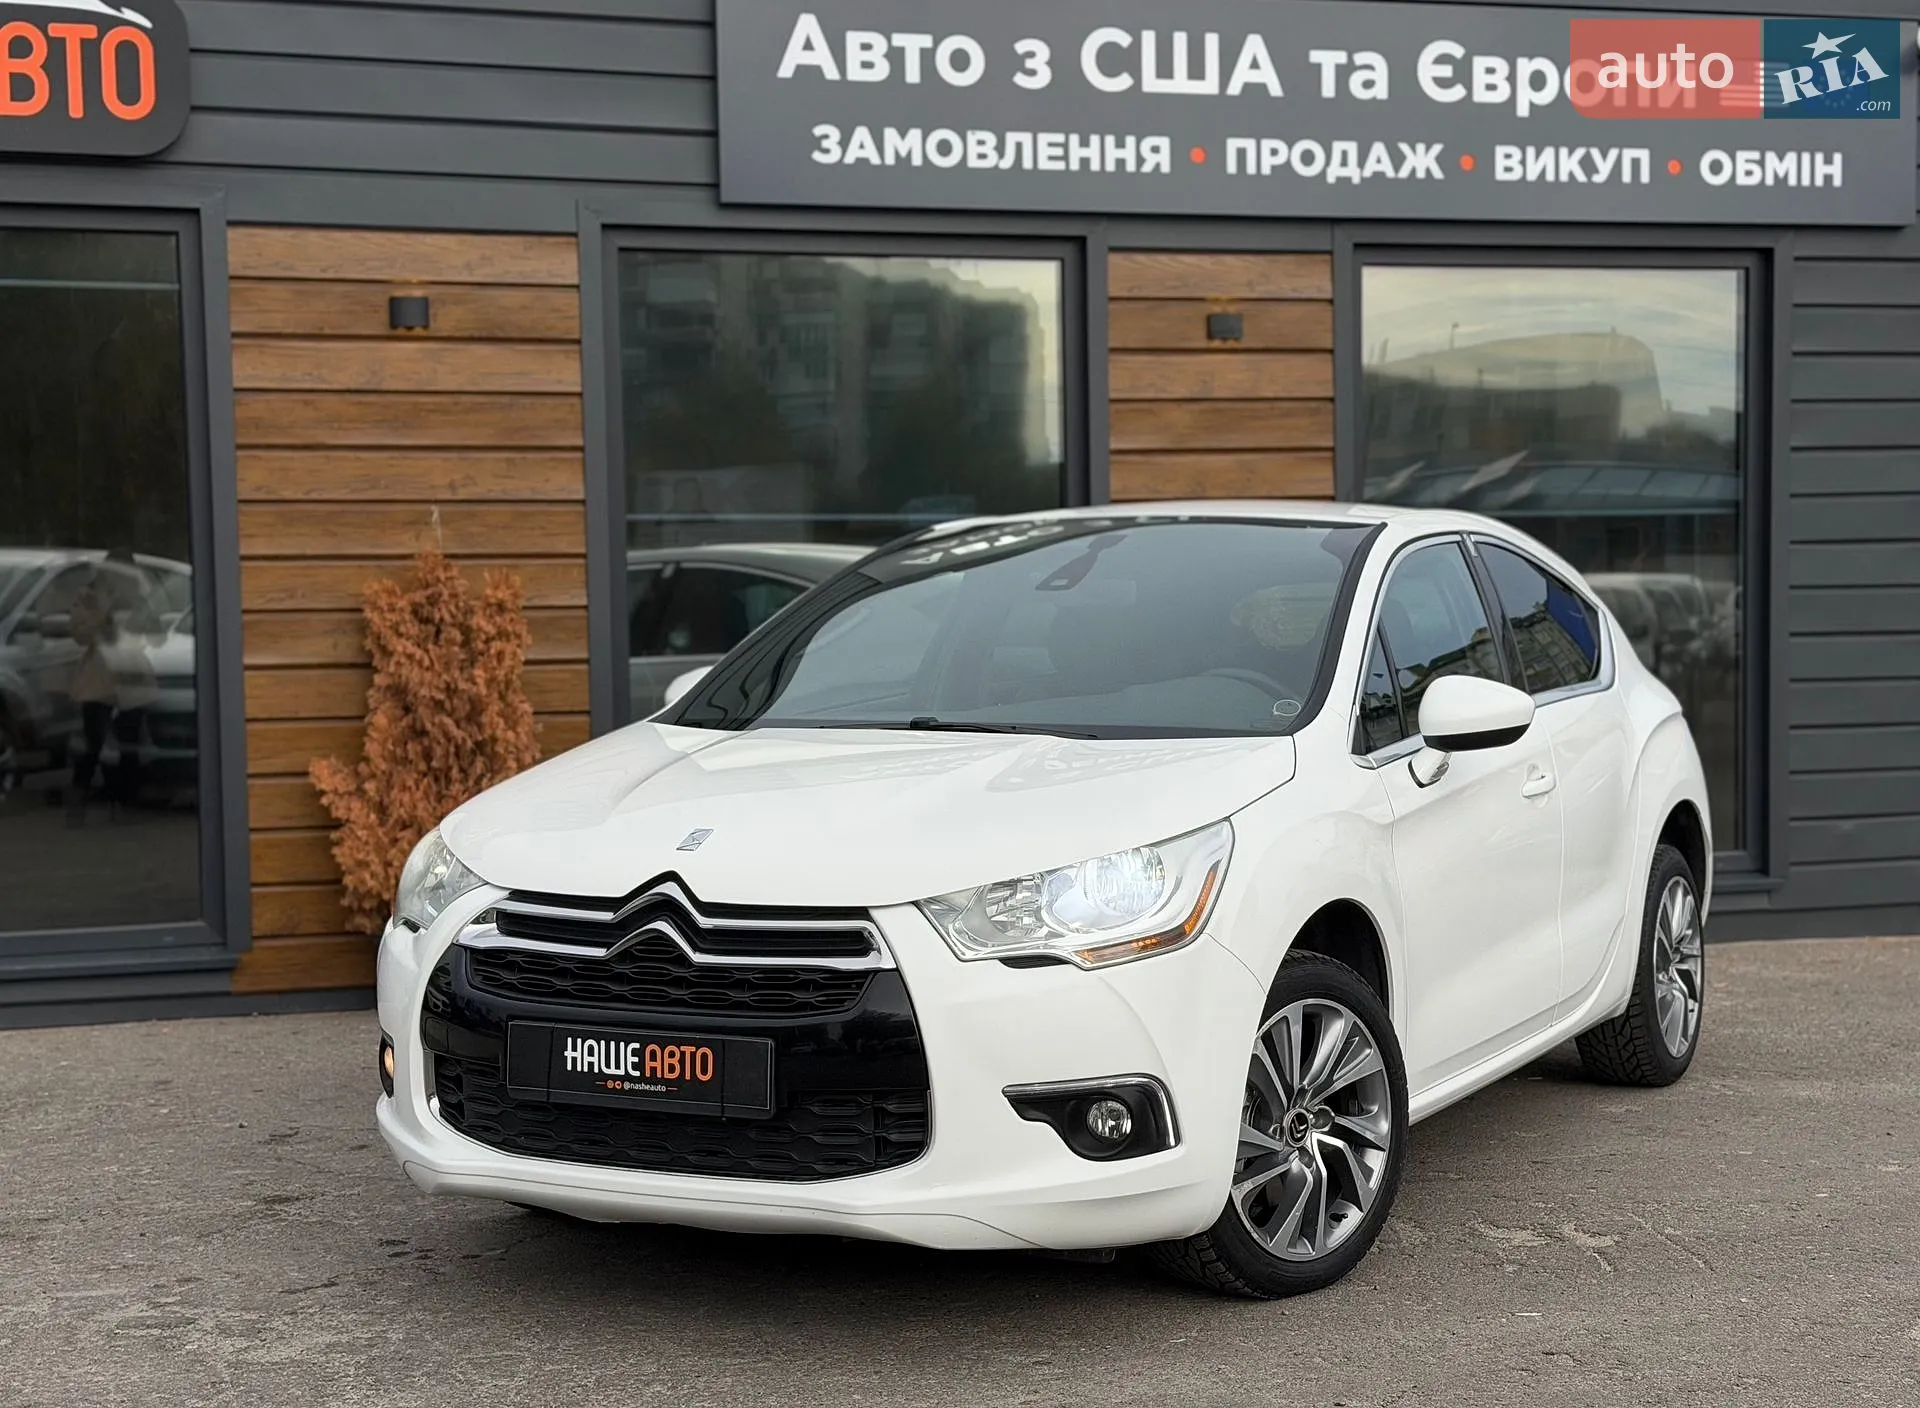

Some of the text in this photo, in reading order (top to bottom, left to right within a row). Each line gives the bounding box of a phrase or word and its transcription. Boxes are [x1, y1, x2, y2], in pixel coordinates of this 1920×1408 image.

[776, 12, 986, 87] Авто
[1012, 38, 1052, 90] з
[1080, 26, 1284, 97] США
[1308, 49, 1389, 101] та
[811, 124, 1843, 187] ЗАМОВЛЕННЯ ПРОДАЖ ВИКУП ОБМІН
[623, 1081, 667, 1093] @nasheauto
